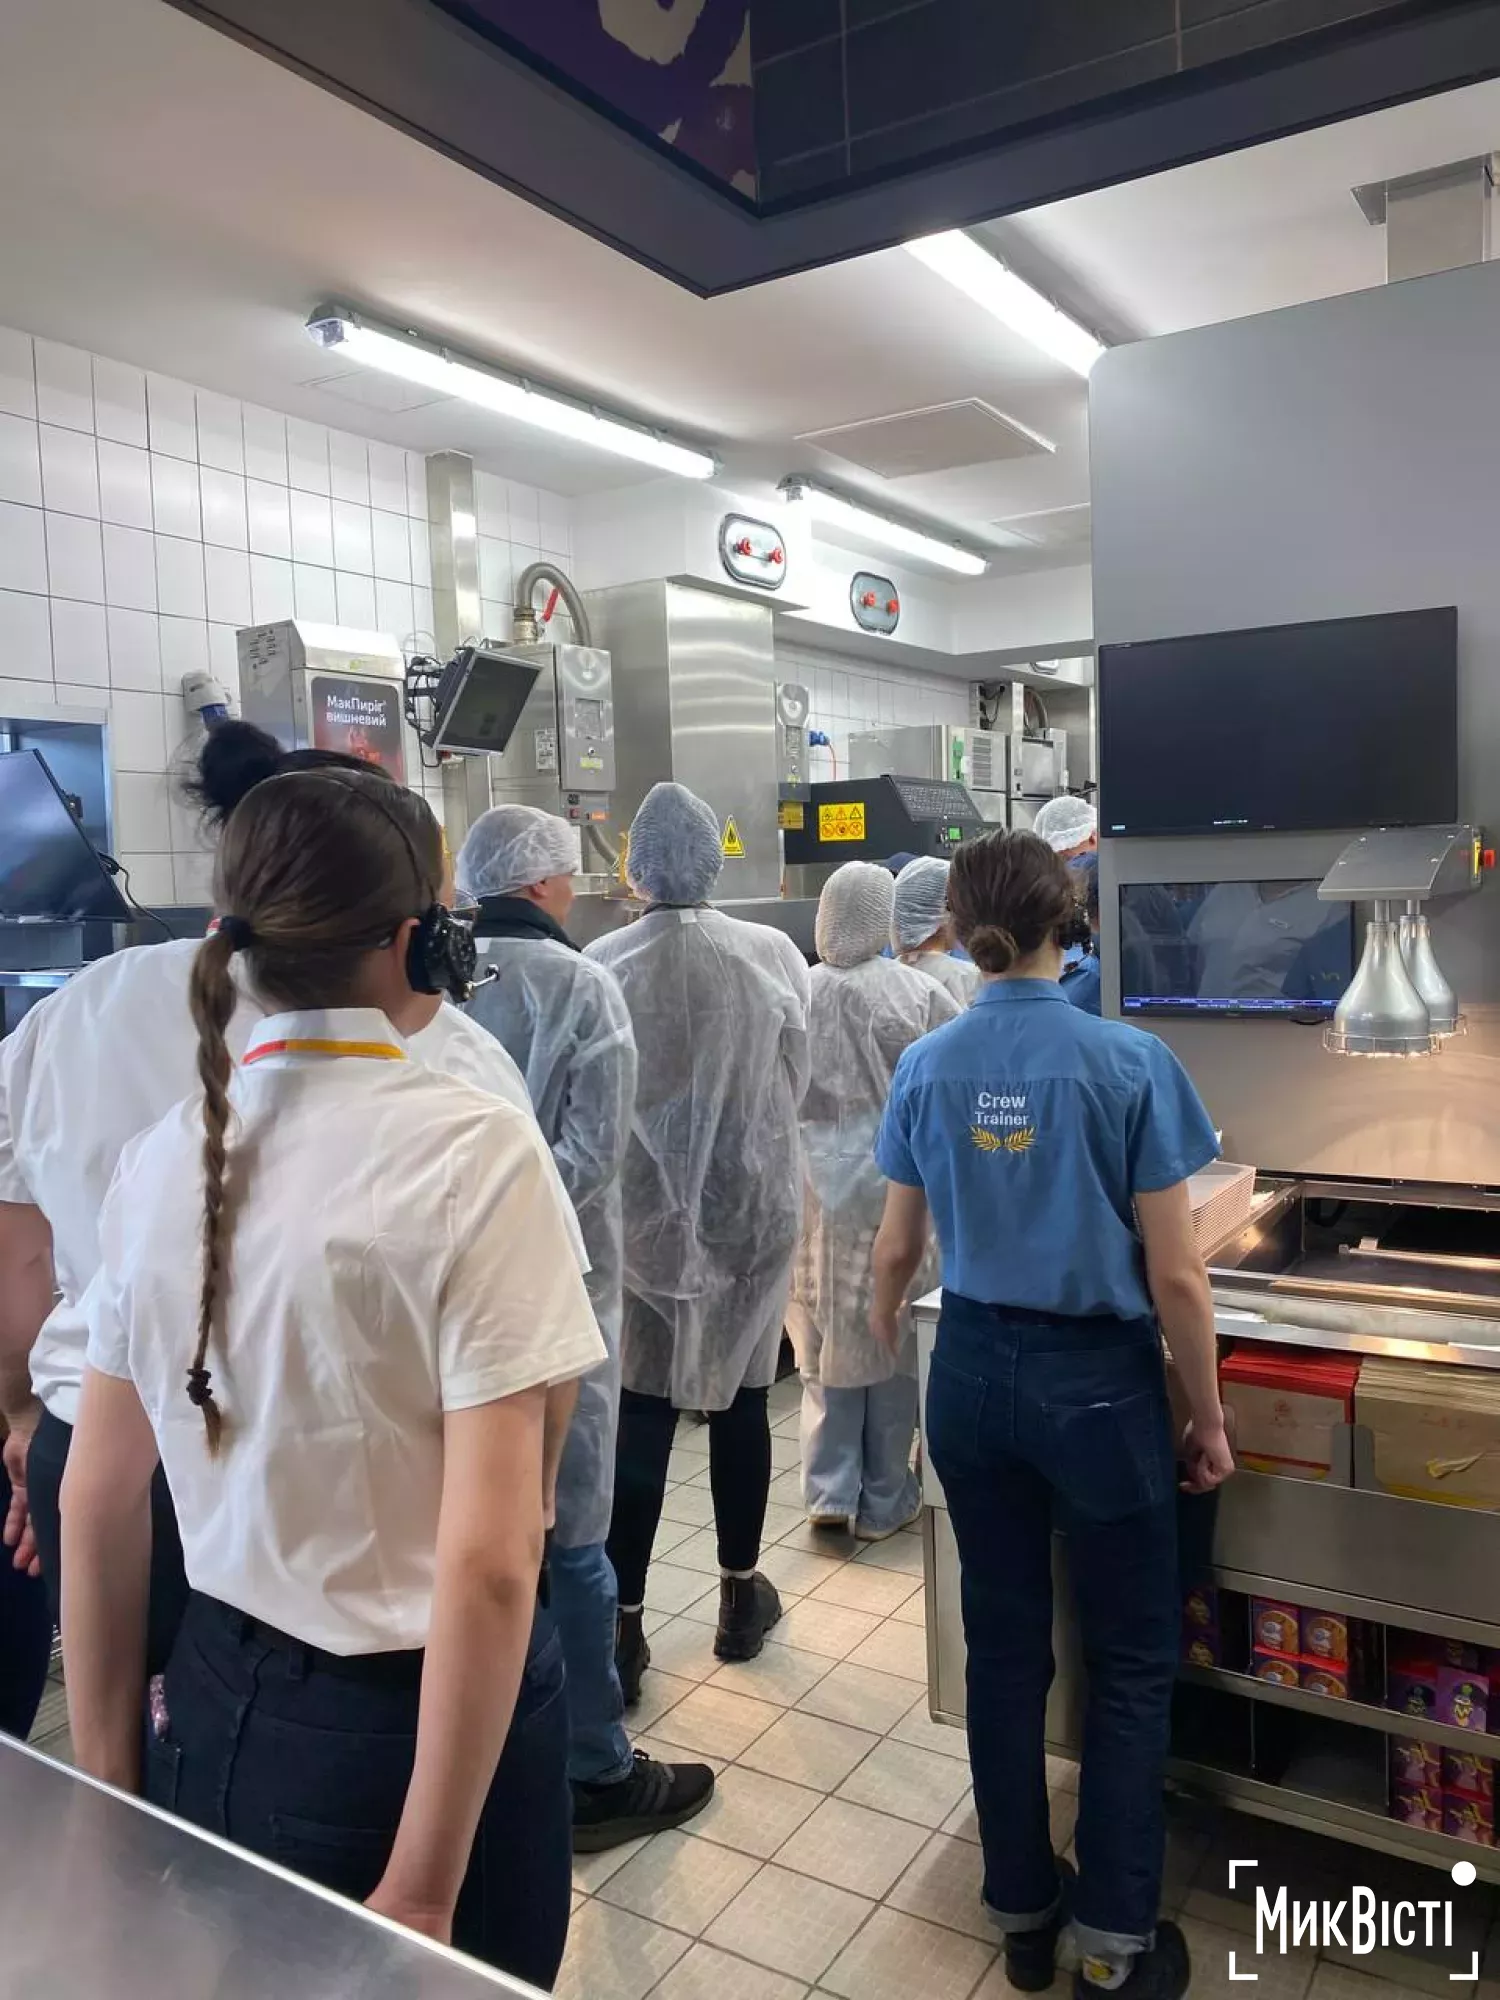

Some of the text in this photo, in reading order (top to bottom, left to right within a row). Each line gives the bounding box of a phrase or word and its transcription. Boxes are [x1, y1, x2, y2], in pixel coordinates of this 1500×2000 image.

[326, 711, 387, 726] вишневий
[977, 1091, 1026, 1109] Crew
[974, 1110, 1030, 1126] Trainer
